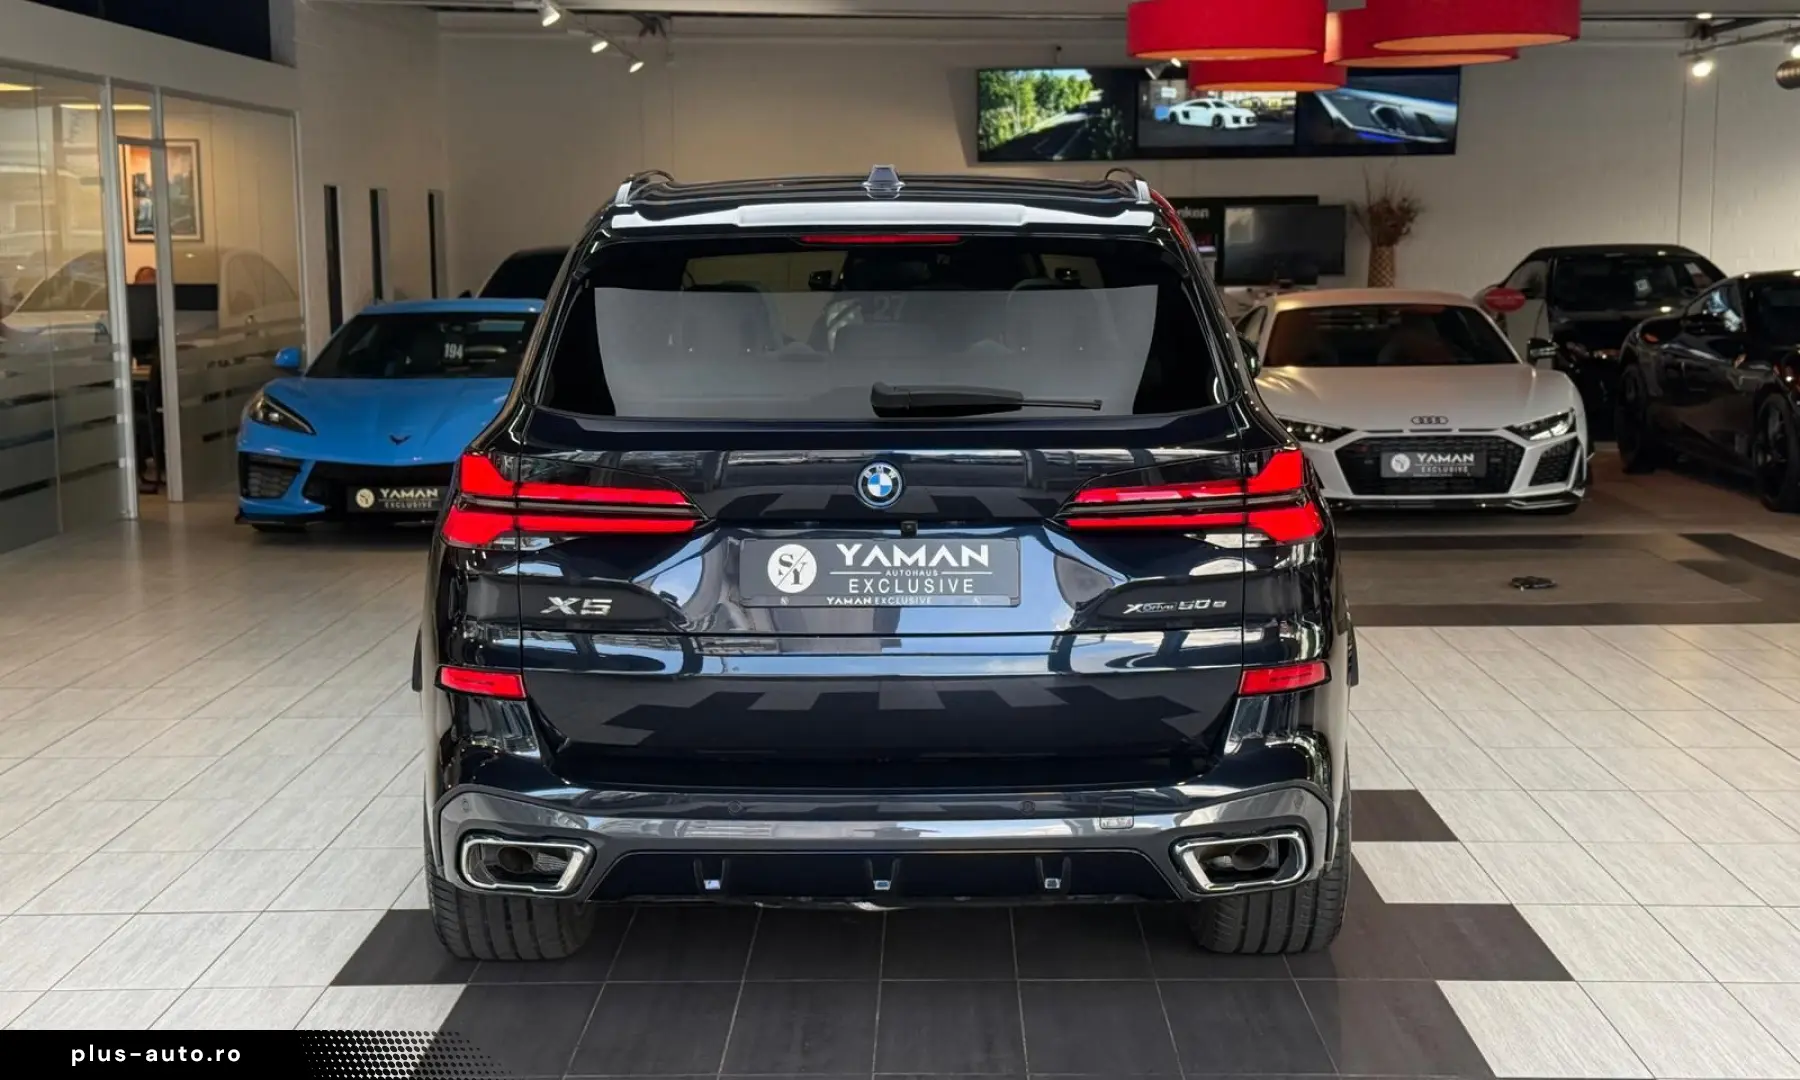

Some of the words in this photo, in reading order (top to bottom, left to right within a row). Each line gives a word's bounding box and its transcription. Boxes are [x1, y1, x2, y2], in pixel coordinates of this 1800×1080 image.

[444, 343, 464, 359] 194
[1416, 453, 1475, 463] YAMAN
[380, 488, 439, 498] YAMAN
[836, 543, 989, 567] YAMAN
[885, 569, 939, 577] AUTOHAUS
[849, 578, 974, 594] EXCLUSIVE
[540, 596, 613, 615] X5
[826, 596, 873, 605] YAMAN
[874, 596, 933, 605] EXCLUSIVE
